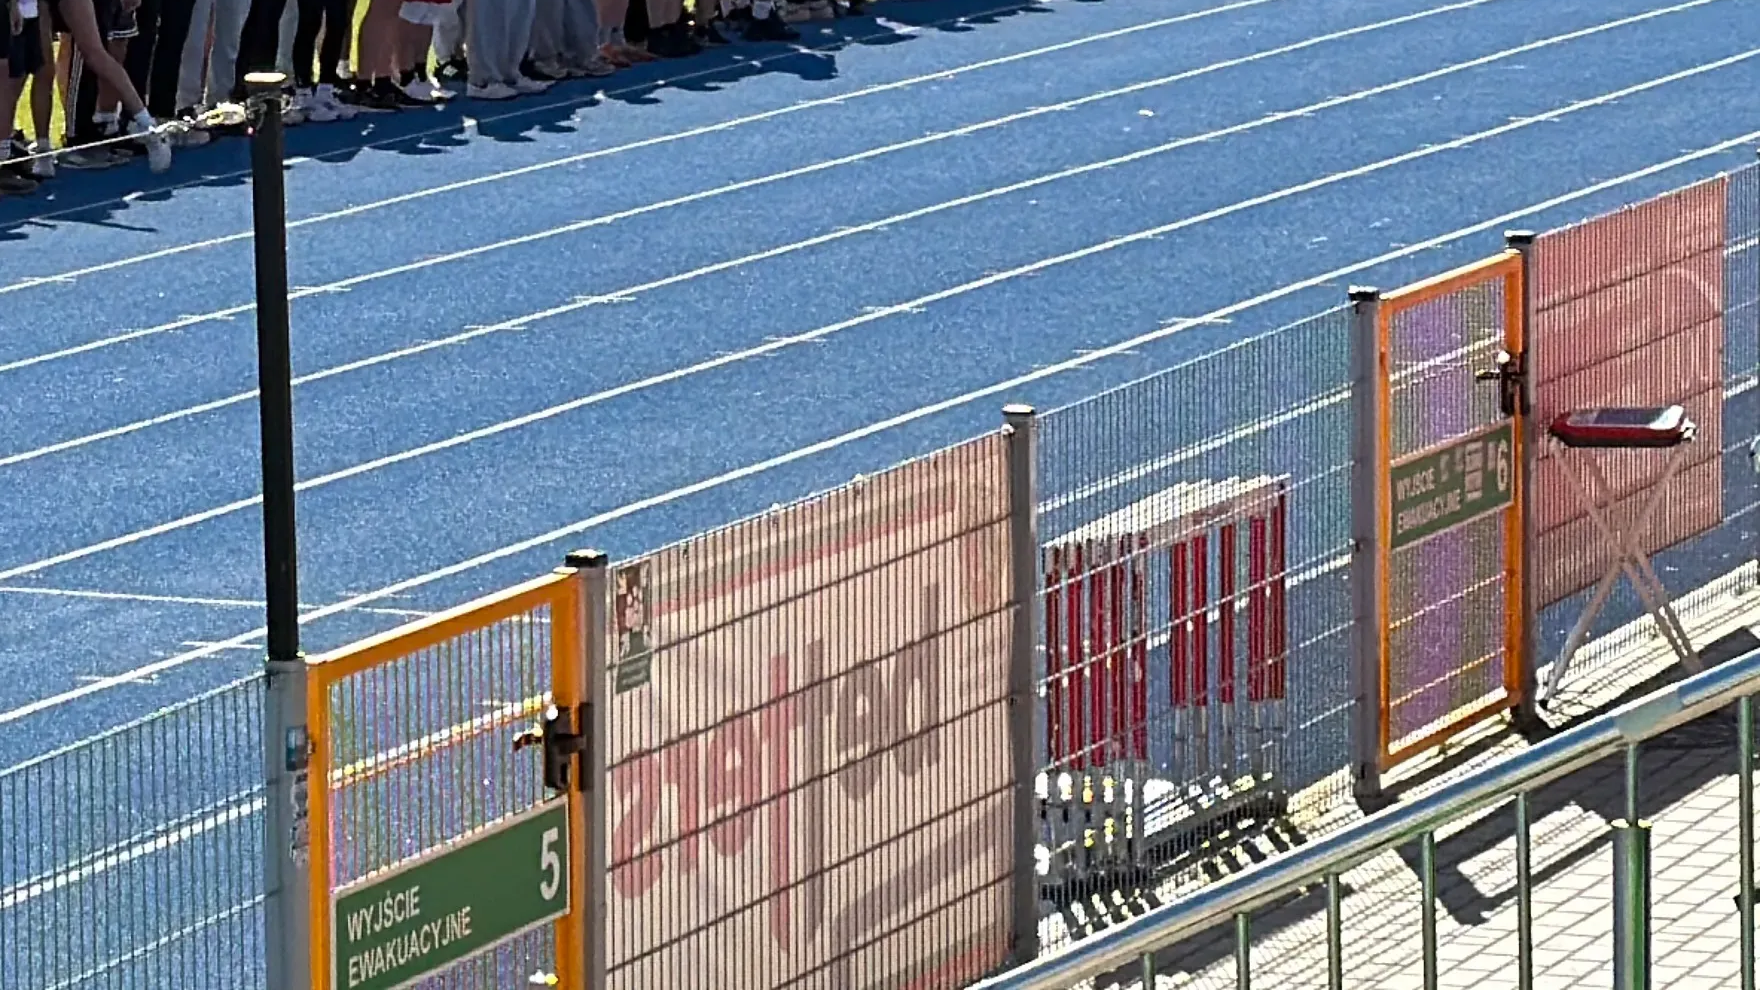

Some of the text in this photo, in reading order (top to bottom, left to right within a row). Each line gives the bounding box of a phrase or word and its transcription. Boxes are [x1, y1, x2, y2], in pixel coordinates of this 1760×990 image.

[1497, 439, 1508, 492] 6
[540, 827, 561, 901] 5
[347, 884, 421, 944] WYJŚCIE
[348, 906, 473, 988] EWAKUACYJNE
